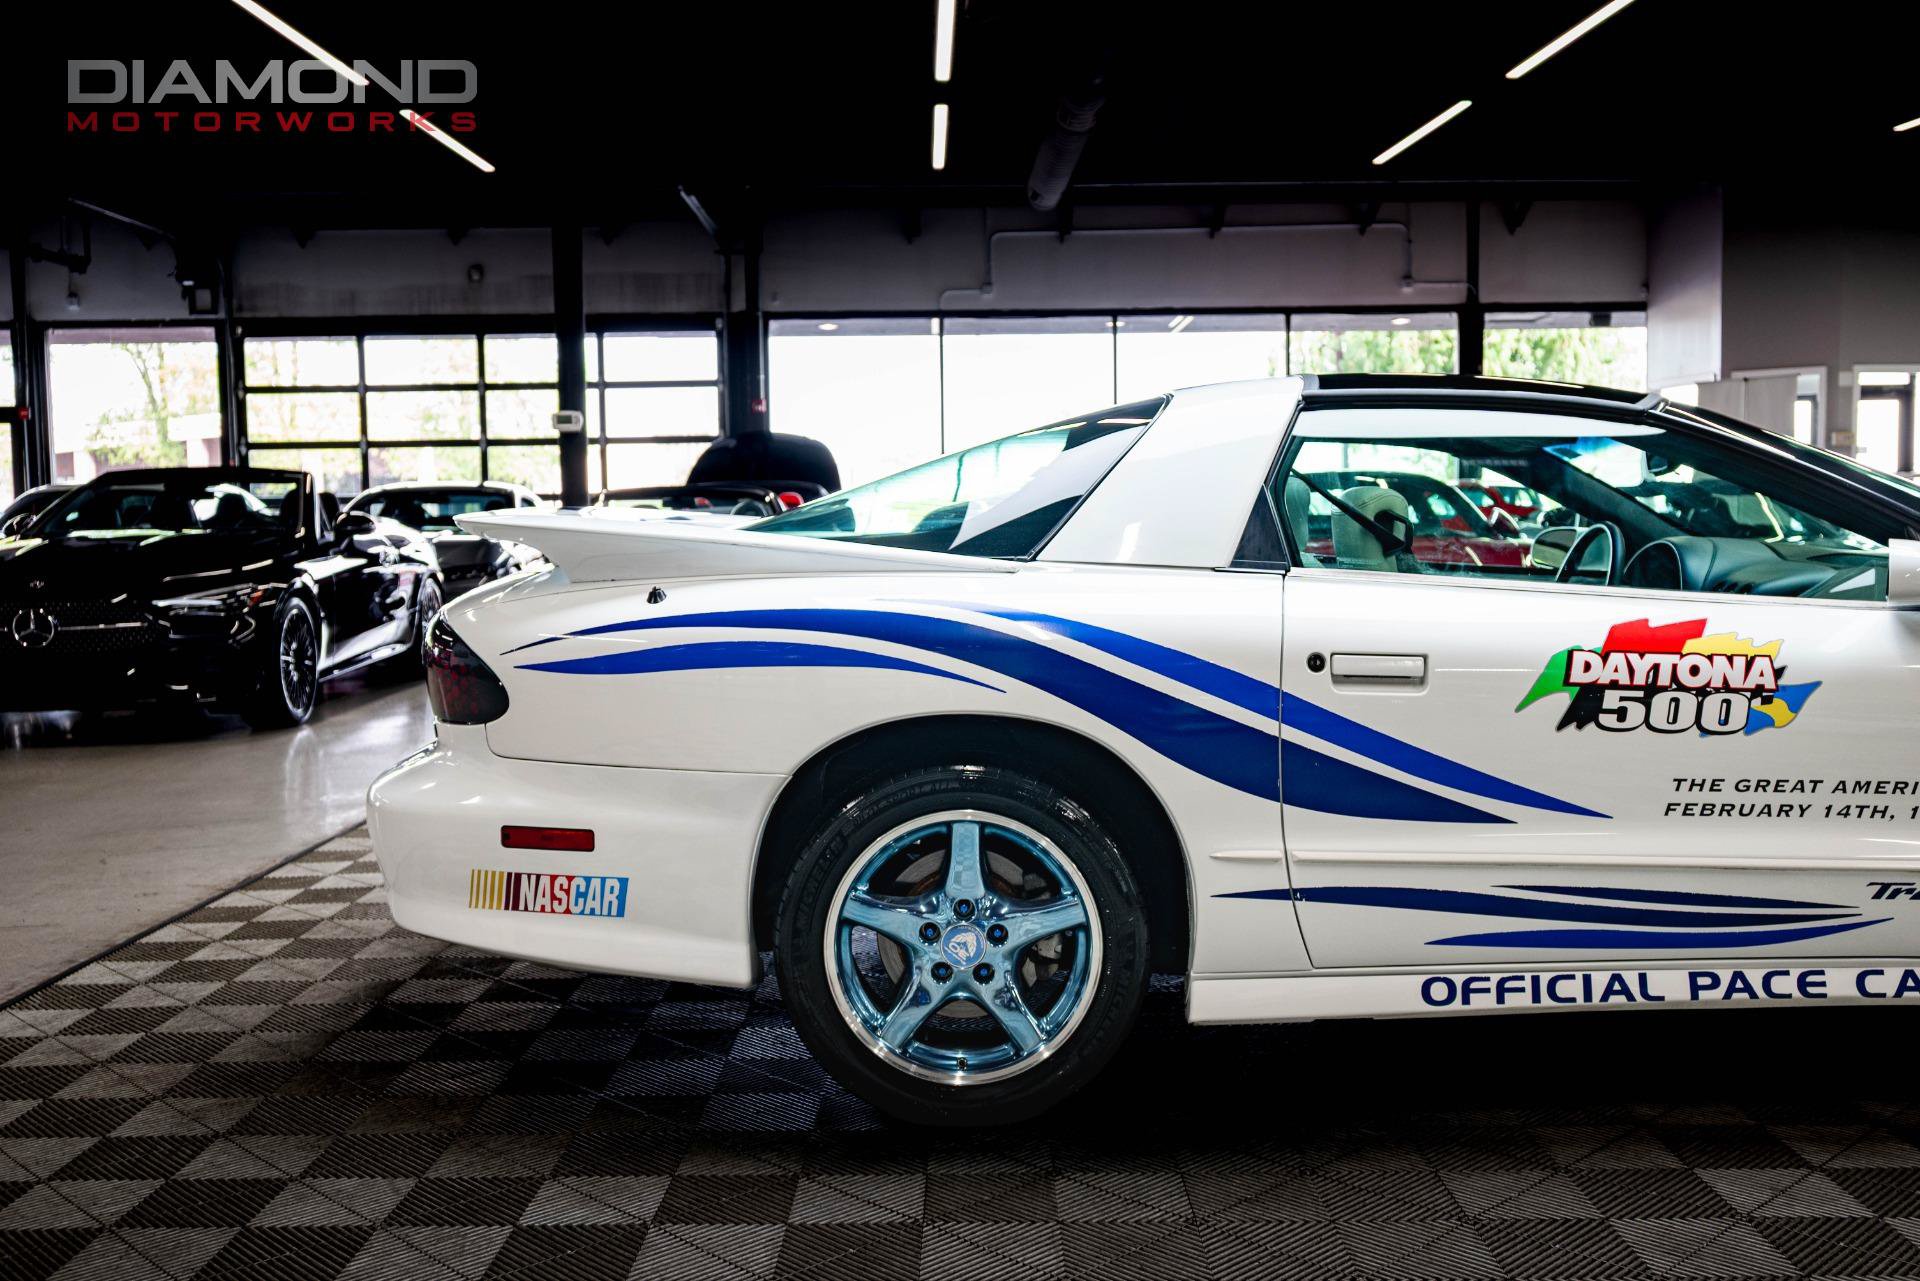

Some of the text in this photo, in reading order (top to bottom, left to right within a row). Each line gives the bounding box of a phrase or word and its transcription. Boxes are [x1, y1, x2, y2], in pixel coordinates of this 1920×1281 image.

[1568, 649, 1777, 690] DAYTONA
[1596, 690, 1750, 733] 500
[1672, 778, 1920, 796] THE GREAT AMERI
[1663, 802, 1920, 822] FEBRUARY 14TH, 1
[518, 873, 621, 917] NASCAR
[1421, 968, 1920, 1007] OFFICIAL PACE CA
